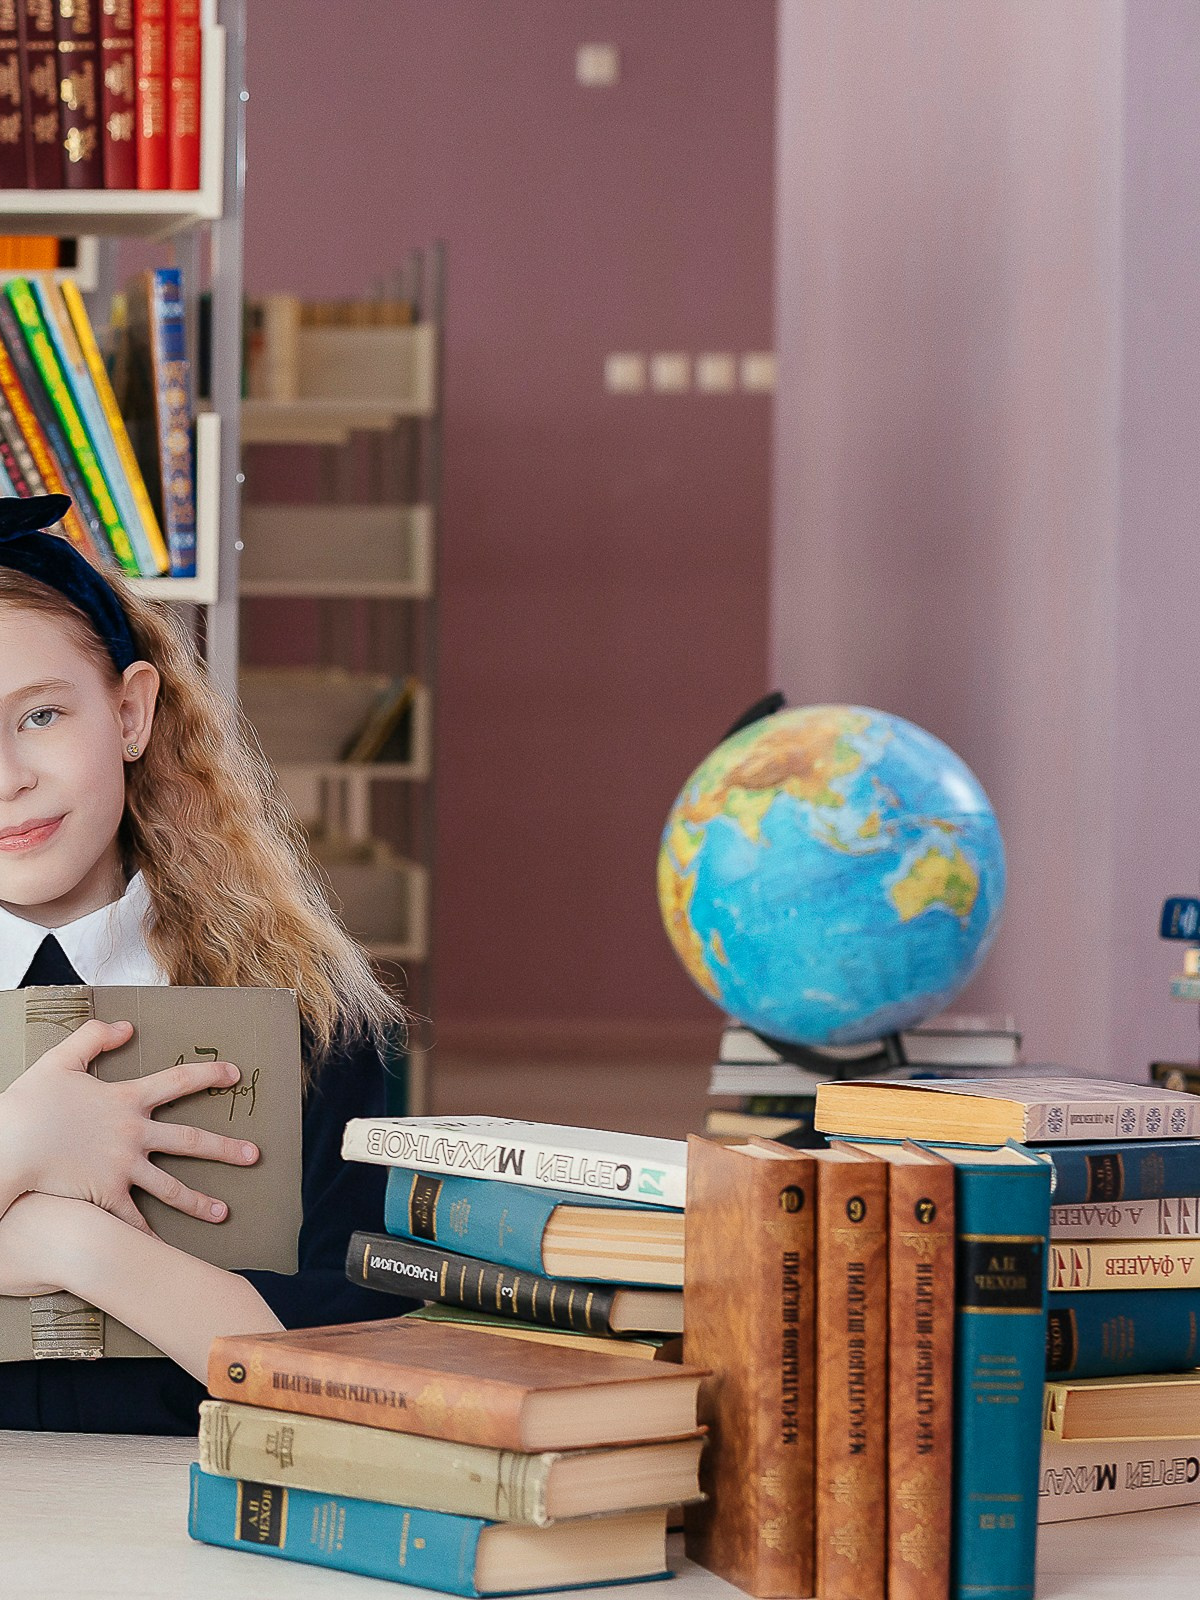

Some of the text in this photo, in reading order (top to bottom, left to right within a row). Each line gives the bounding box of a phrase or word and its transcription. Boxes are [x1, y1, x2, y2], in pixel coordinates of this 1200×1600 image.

[366, 1128, 632, 1191] СЕРГЕЙ МИХАЛКОВ
[642, 1170, 666, 1195] 2
[780, 1190, 799, 1208] 10
[850, 1202, 863, 1220] 9
[918, 1203, 933, 1222] 7
[1125, 1207, 1144, 1225] А.
[1105, 1255, 1195, 1278] А. ФАДЕЕВ
[502, 1285, 514, 1298] 3
[231, 1365, 244, 1380] 8
[1126, 1457, 1200, 1490] СЕРГЕЙ
[259, 1488, 273, 1544] ЧЕХОВ
